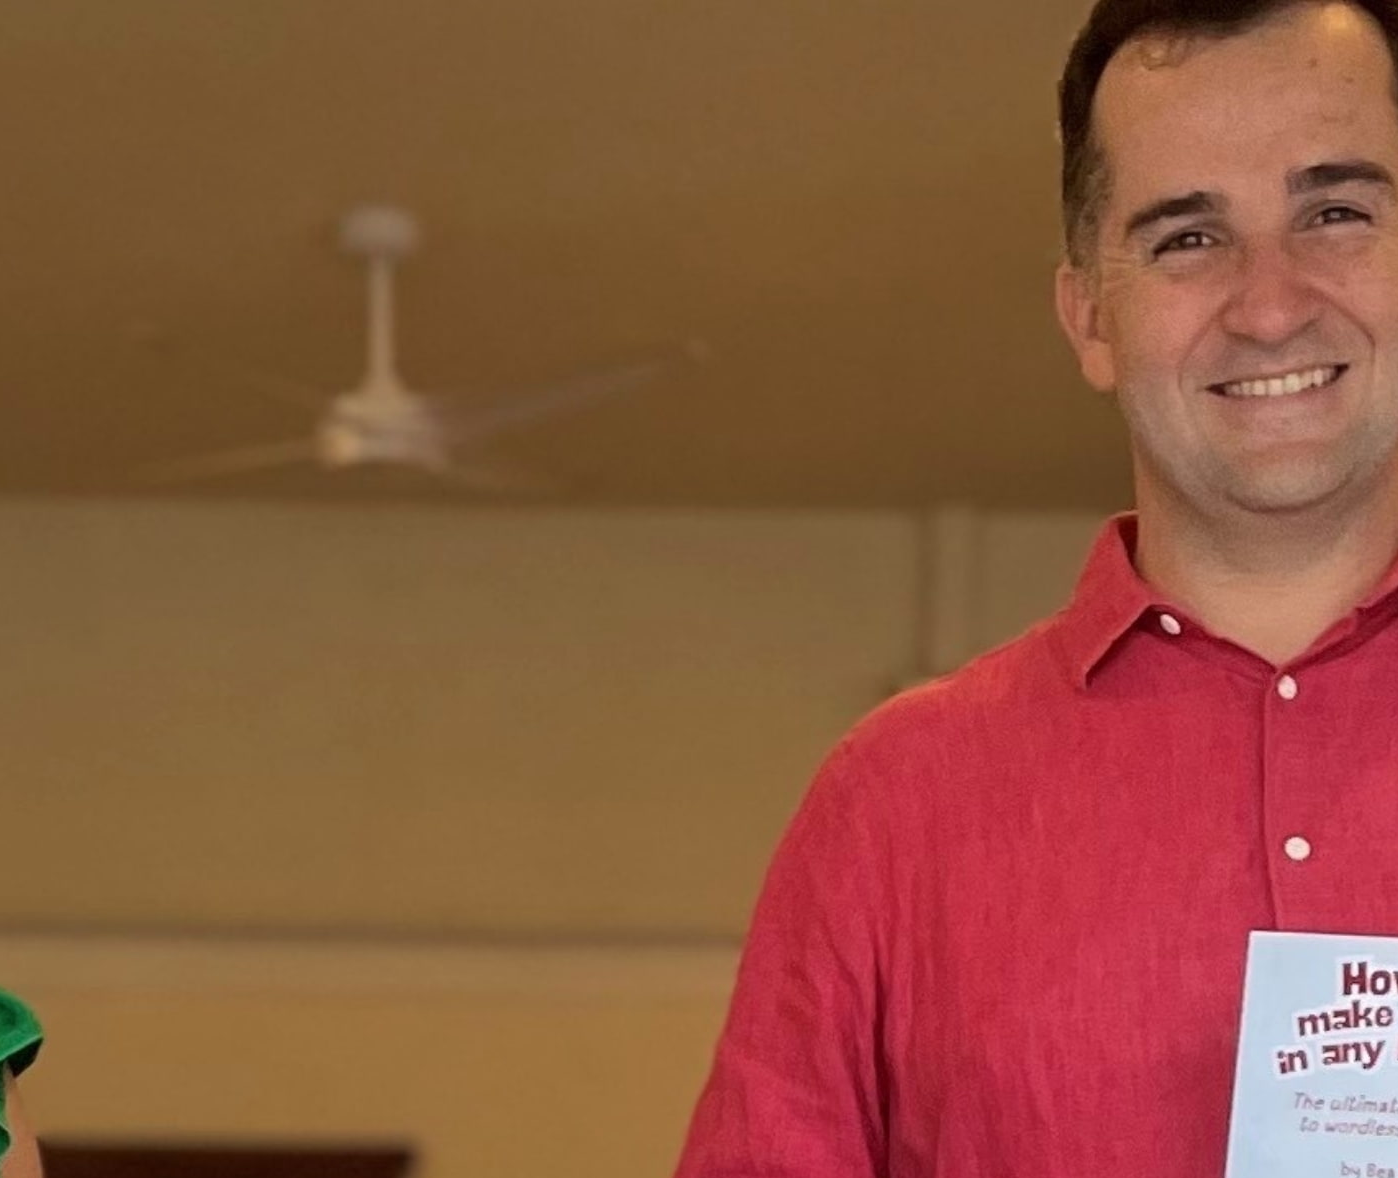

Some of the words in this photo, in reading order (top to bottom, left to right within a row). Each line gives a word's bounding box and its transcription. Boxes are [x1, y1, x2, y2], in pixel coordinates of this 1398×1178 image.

[1297, 1000, 1393, 1037] make
[1277, 1050, 1308, 1076] in
[1322, 1039, 1385, 1071] any
[1294, 1091, 1325, 1110] The
[1300, 1116, 1319, 1133] to
